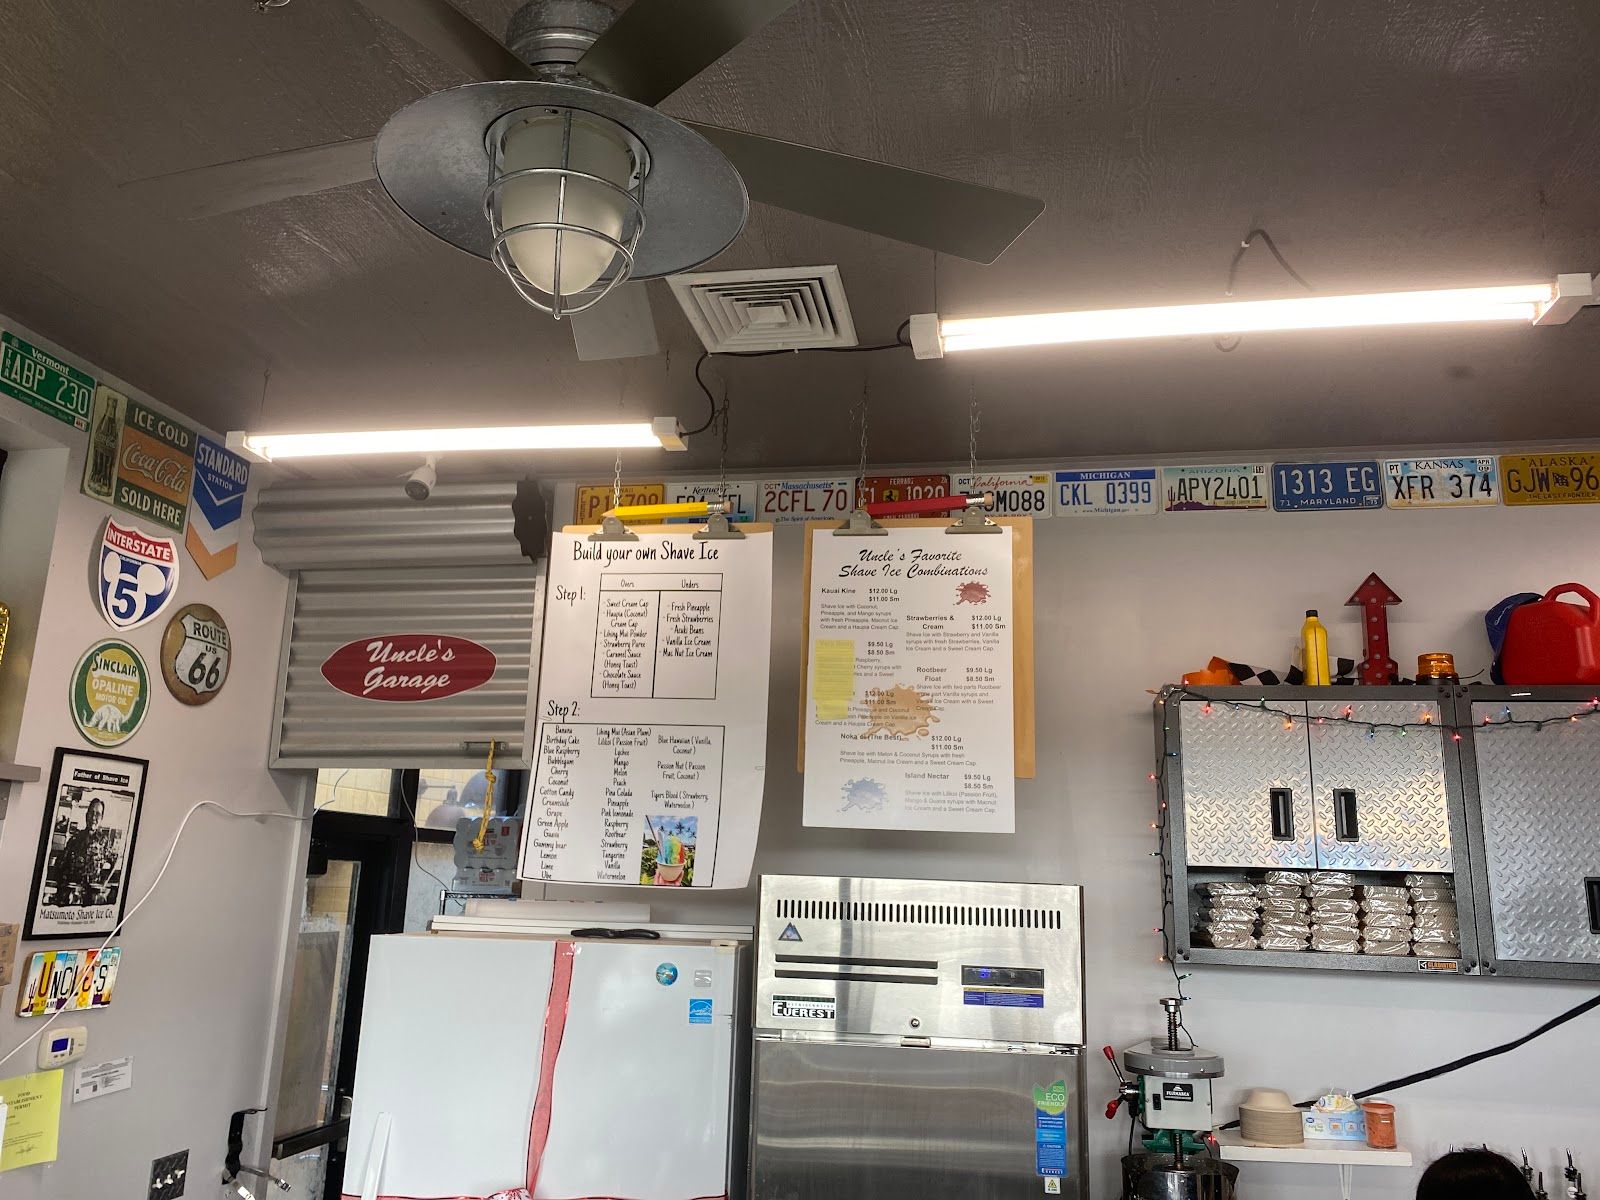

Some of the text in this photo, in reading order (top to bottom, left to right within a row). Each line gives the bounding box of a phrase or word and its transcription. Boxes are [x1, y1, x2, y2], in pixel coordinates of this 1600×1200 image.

[32, 348, 69, 376] Vermont
[10, 354, 88, 414] ABP 230
[134, 407, 188, 447] ICE COLD
[197, 443, 248, 485] STANDARD
[1389, 464, 1399, 474] PT
[1415, 460, 1464, 470] KANSAS
[1529, 456, 1588, 467] ALASKA
[208, 473, 233, 491] STATION
[973, 476, 1030, 490] California
[1080, 472, 1131, 480] MICHIGAN
[1280, 467, 1375, 495] 1313 EG
[1507, 466, 1599, 493] GJW 96
[781, 482, 832, 490] Massachusetts
[1060, 481, 1151, 505] CKL 0399
[1178, 476, 1262, 500] APY2401
[1392, 473, 1492, 499] XFR 374
[120, 487, 181, 525] SOLD HERE
[764, 490, 815, 512] 2CFL
[822, 489, 847, 512] 70
[1300, 497, 1356, 505] MARYLAND
[107, 527, 171, 560] INTERSTATE
[573, 540, 719, 568] Build your own Shave Ice
[858, 548, 962, 564] Uncle's Favorite
[838, 563, 988, 579] Shave Ice Combinations
[112, 578, 138, 619] 5
[556, 585, 577, 606] Step
[671, 601, 685, 611] Fresh
[666, 613, 714, 622] Fresh Strawberries
[193, 621, 226, 646] ROUTE
[690, 624, 704, 634] Beans
[205, 645, 217, 654] US
[684, 636, 693, 645] Ice
[694, 636, 711, 646] Cream
[366, 639, 456, 663] Uncle's
[685, 648, 694, 657] Ice
[696, 648, 713, 657] Cream
[92, 652, 137, 677] SINCLAIR
[188, 652, 221, 689] 66
[92, 679, 134, 697] OPALINE
[362, 666, 450, 695] Garage
[95, 692, 127, 705] MOTOR OIL
[547, 700, 568, 723] Step
[555, 725, 573, 734] Banana
[74, 770, 92, 780] Father
[102, 774, 118, 783] Shave
[120, 776, 129, 784] Ice
[551, 766, 568, 778] Cherry
[540, 786, 575, 800] Cotton Candy
[39, 908, 114, 920] Matsumoto Shave Ice Co.
[1045, 1092, 1064, 1102] ECO
